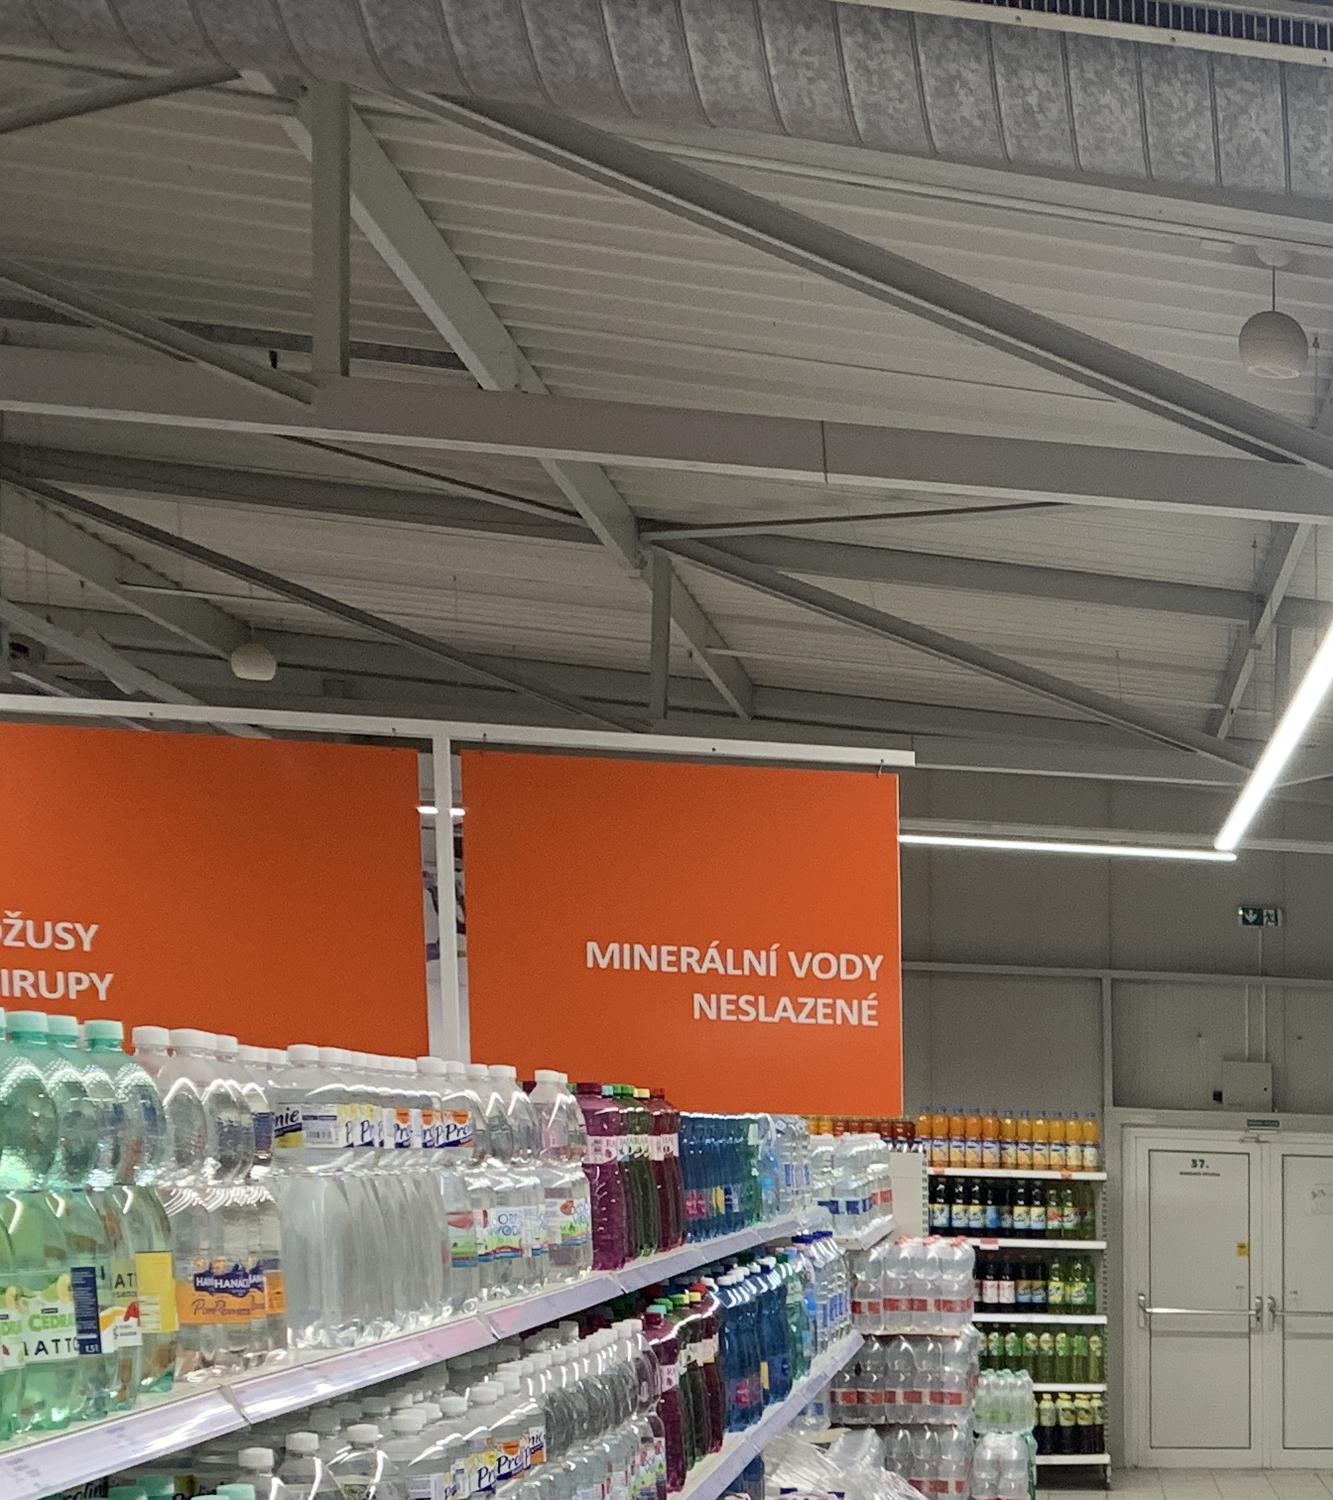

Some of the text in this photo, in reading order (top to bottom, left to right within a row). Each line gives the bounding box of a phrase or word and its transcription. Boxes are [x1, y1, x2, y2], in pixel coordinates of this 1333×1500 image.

[0, 909, 99, 952] ŽUSY
[585, 940, 884, 981] MINERÁLNÍ VODY
[0, 968, 114, 1001] IRUPY
[693, 992, 879, 1026] NESLAZENÉ
